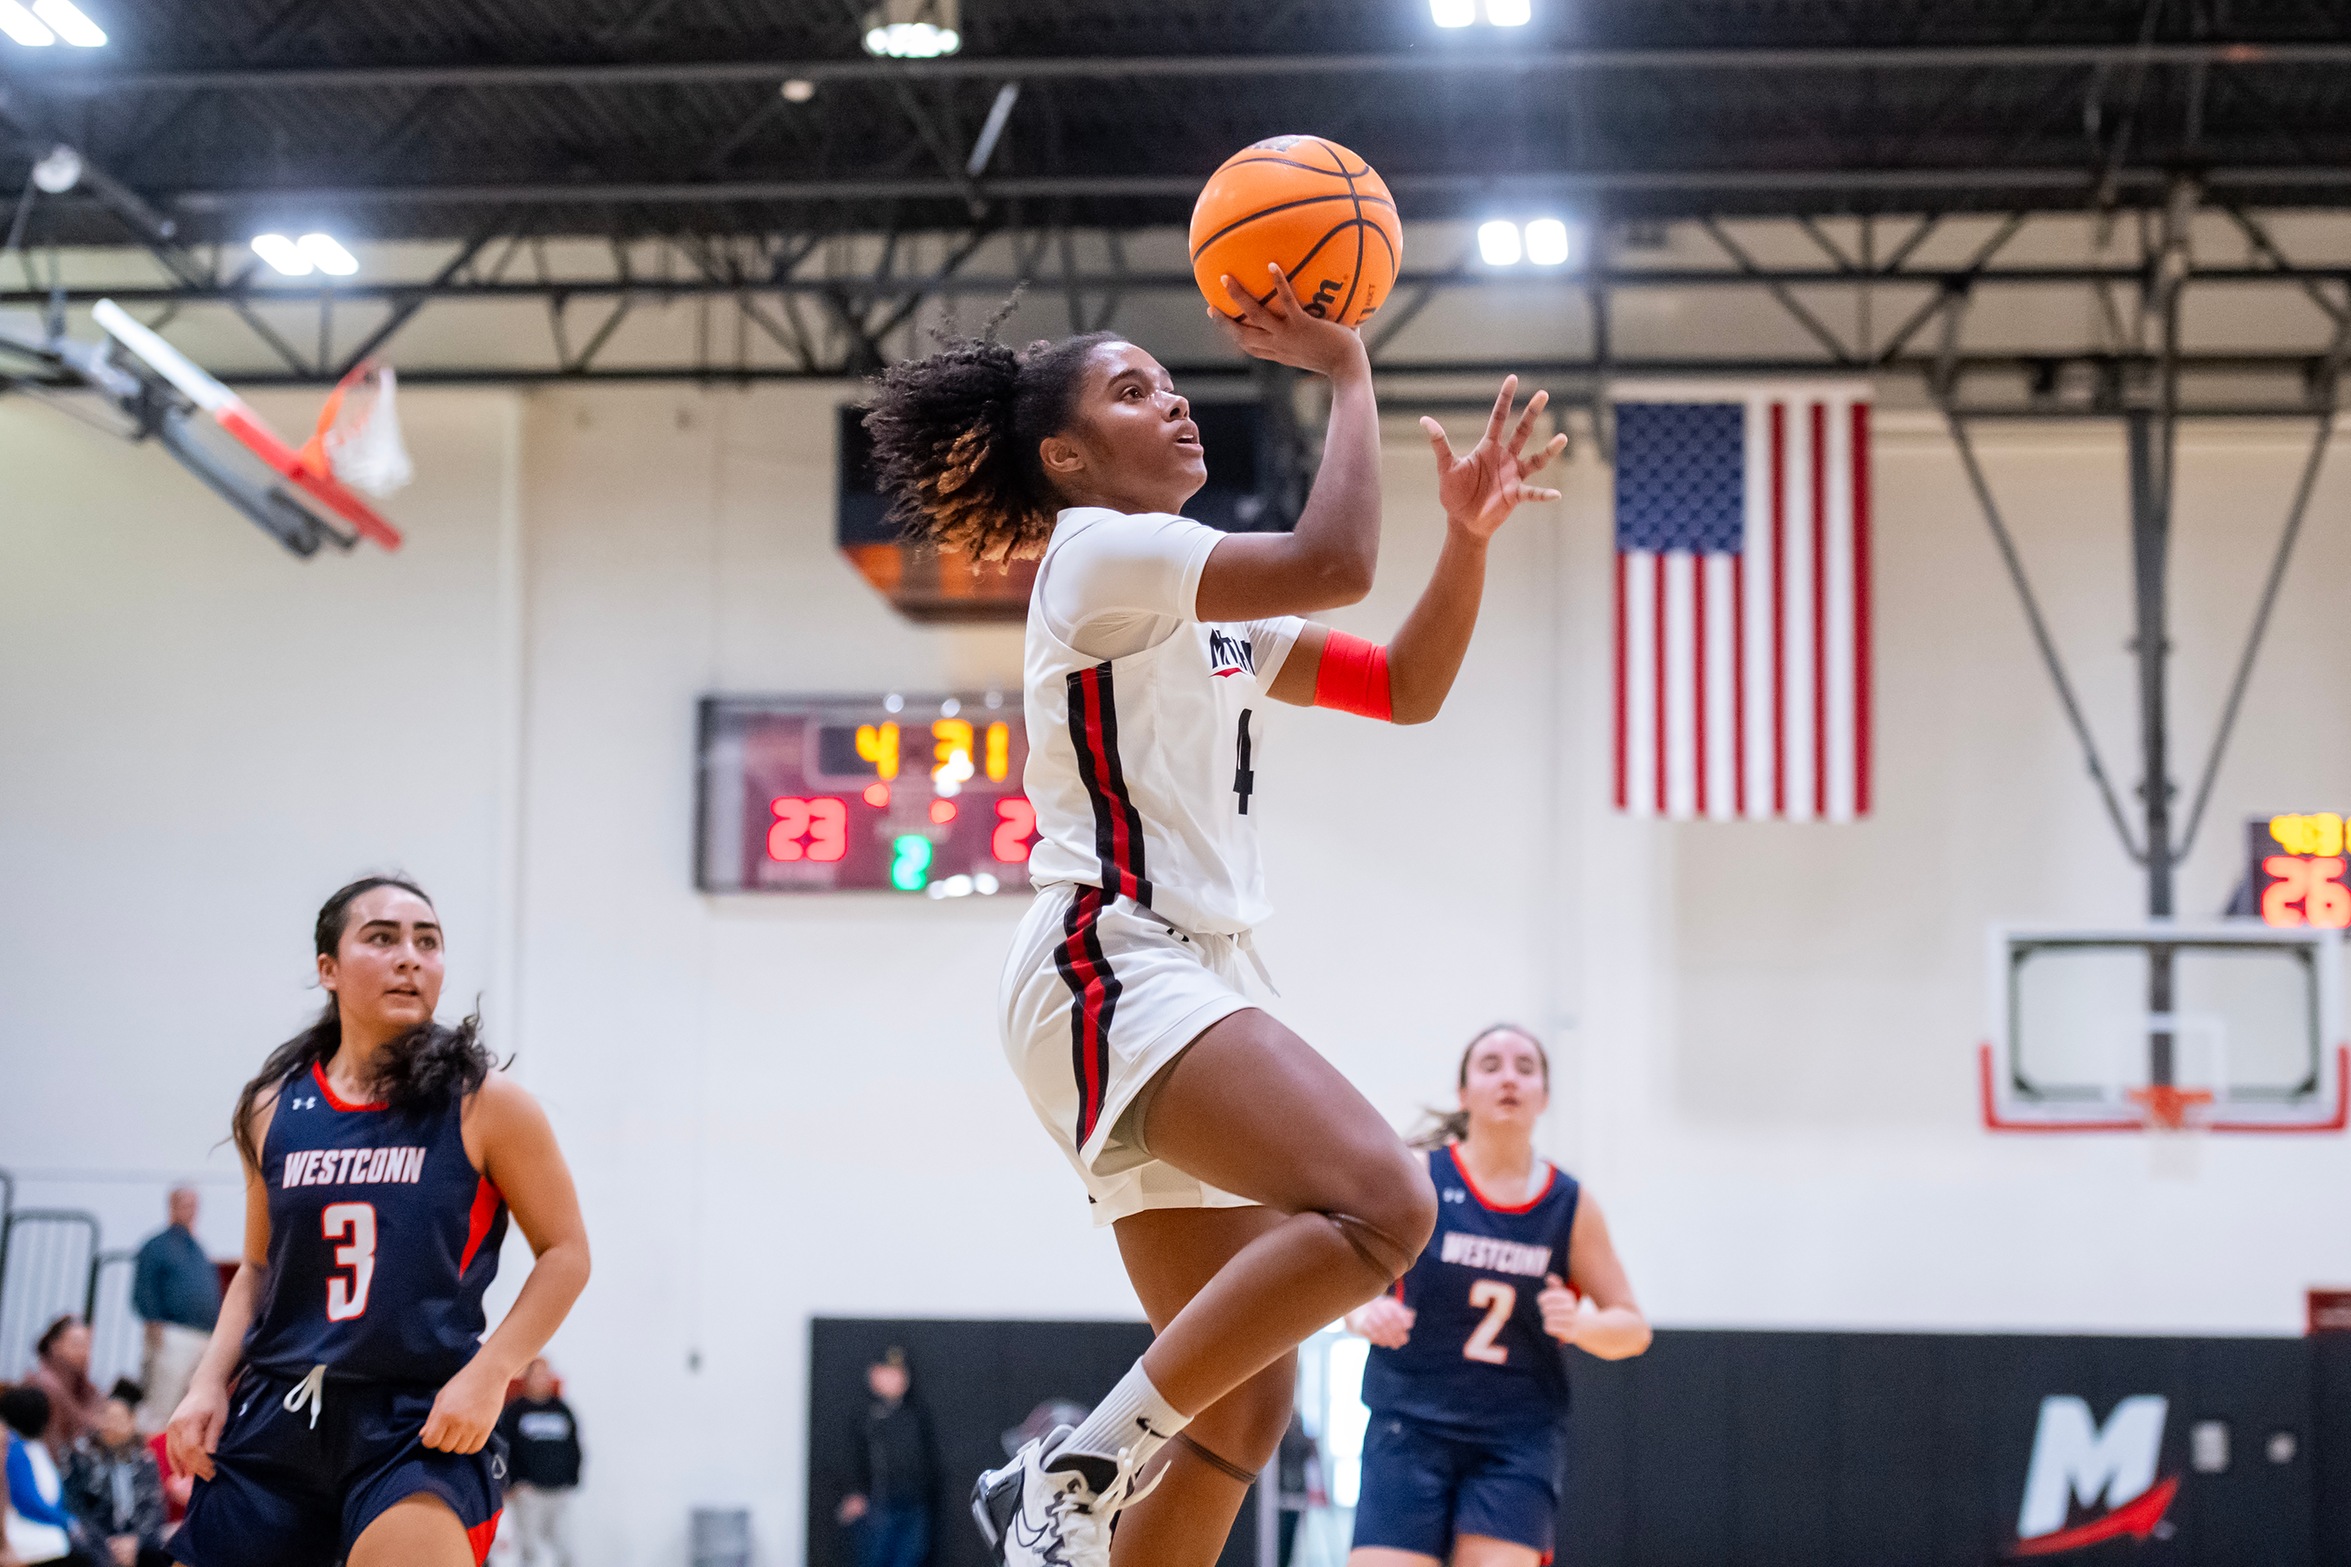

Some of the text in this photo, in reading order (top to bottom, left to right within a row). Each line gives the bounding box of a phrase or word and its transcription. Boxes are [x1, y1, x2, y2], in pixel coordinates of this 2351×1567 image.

[856, 719, 1009, 782] 4 31
[1233, 708, 1254, 815] 4
[767, 797, 848, 862] 23
[894, 835, 932, 892] 2
[2261, 856, 2351, 929] 26
[282, 1146, 427, 1189] WESTCONN
[321, 1201, 377, 1323] 3
[1462, 1278, 1516, 1365] 2
[2017, 1394, 2169, 1539] M
